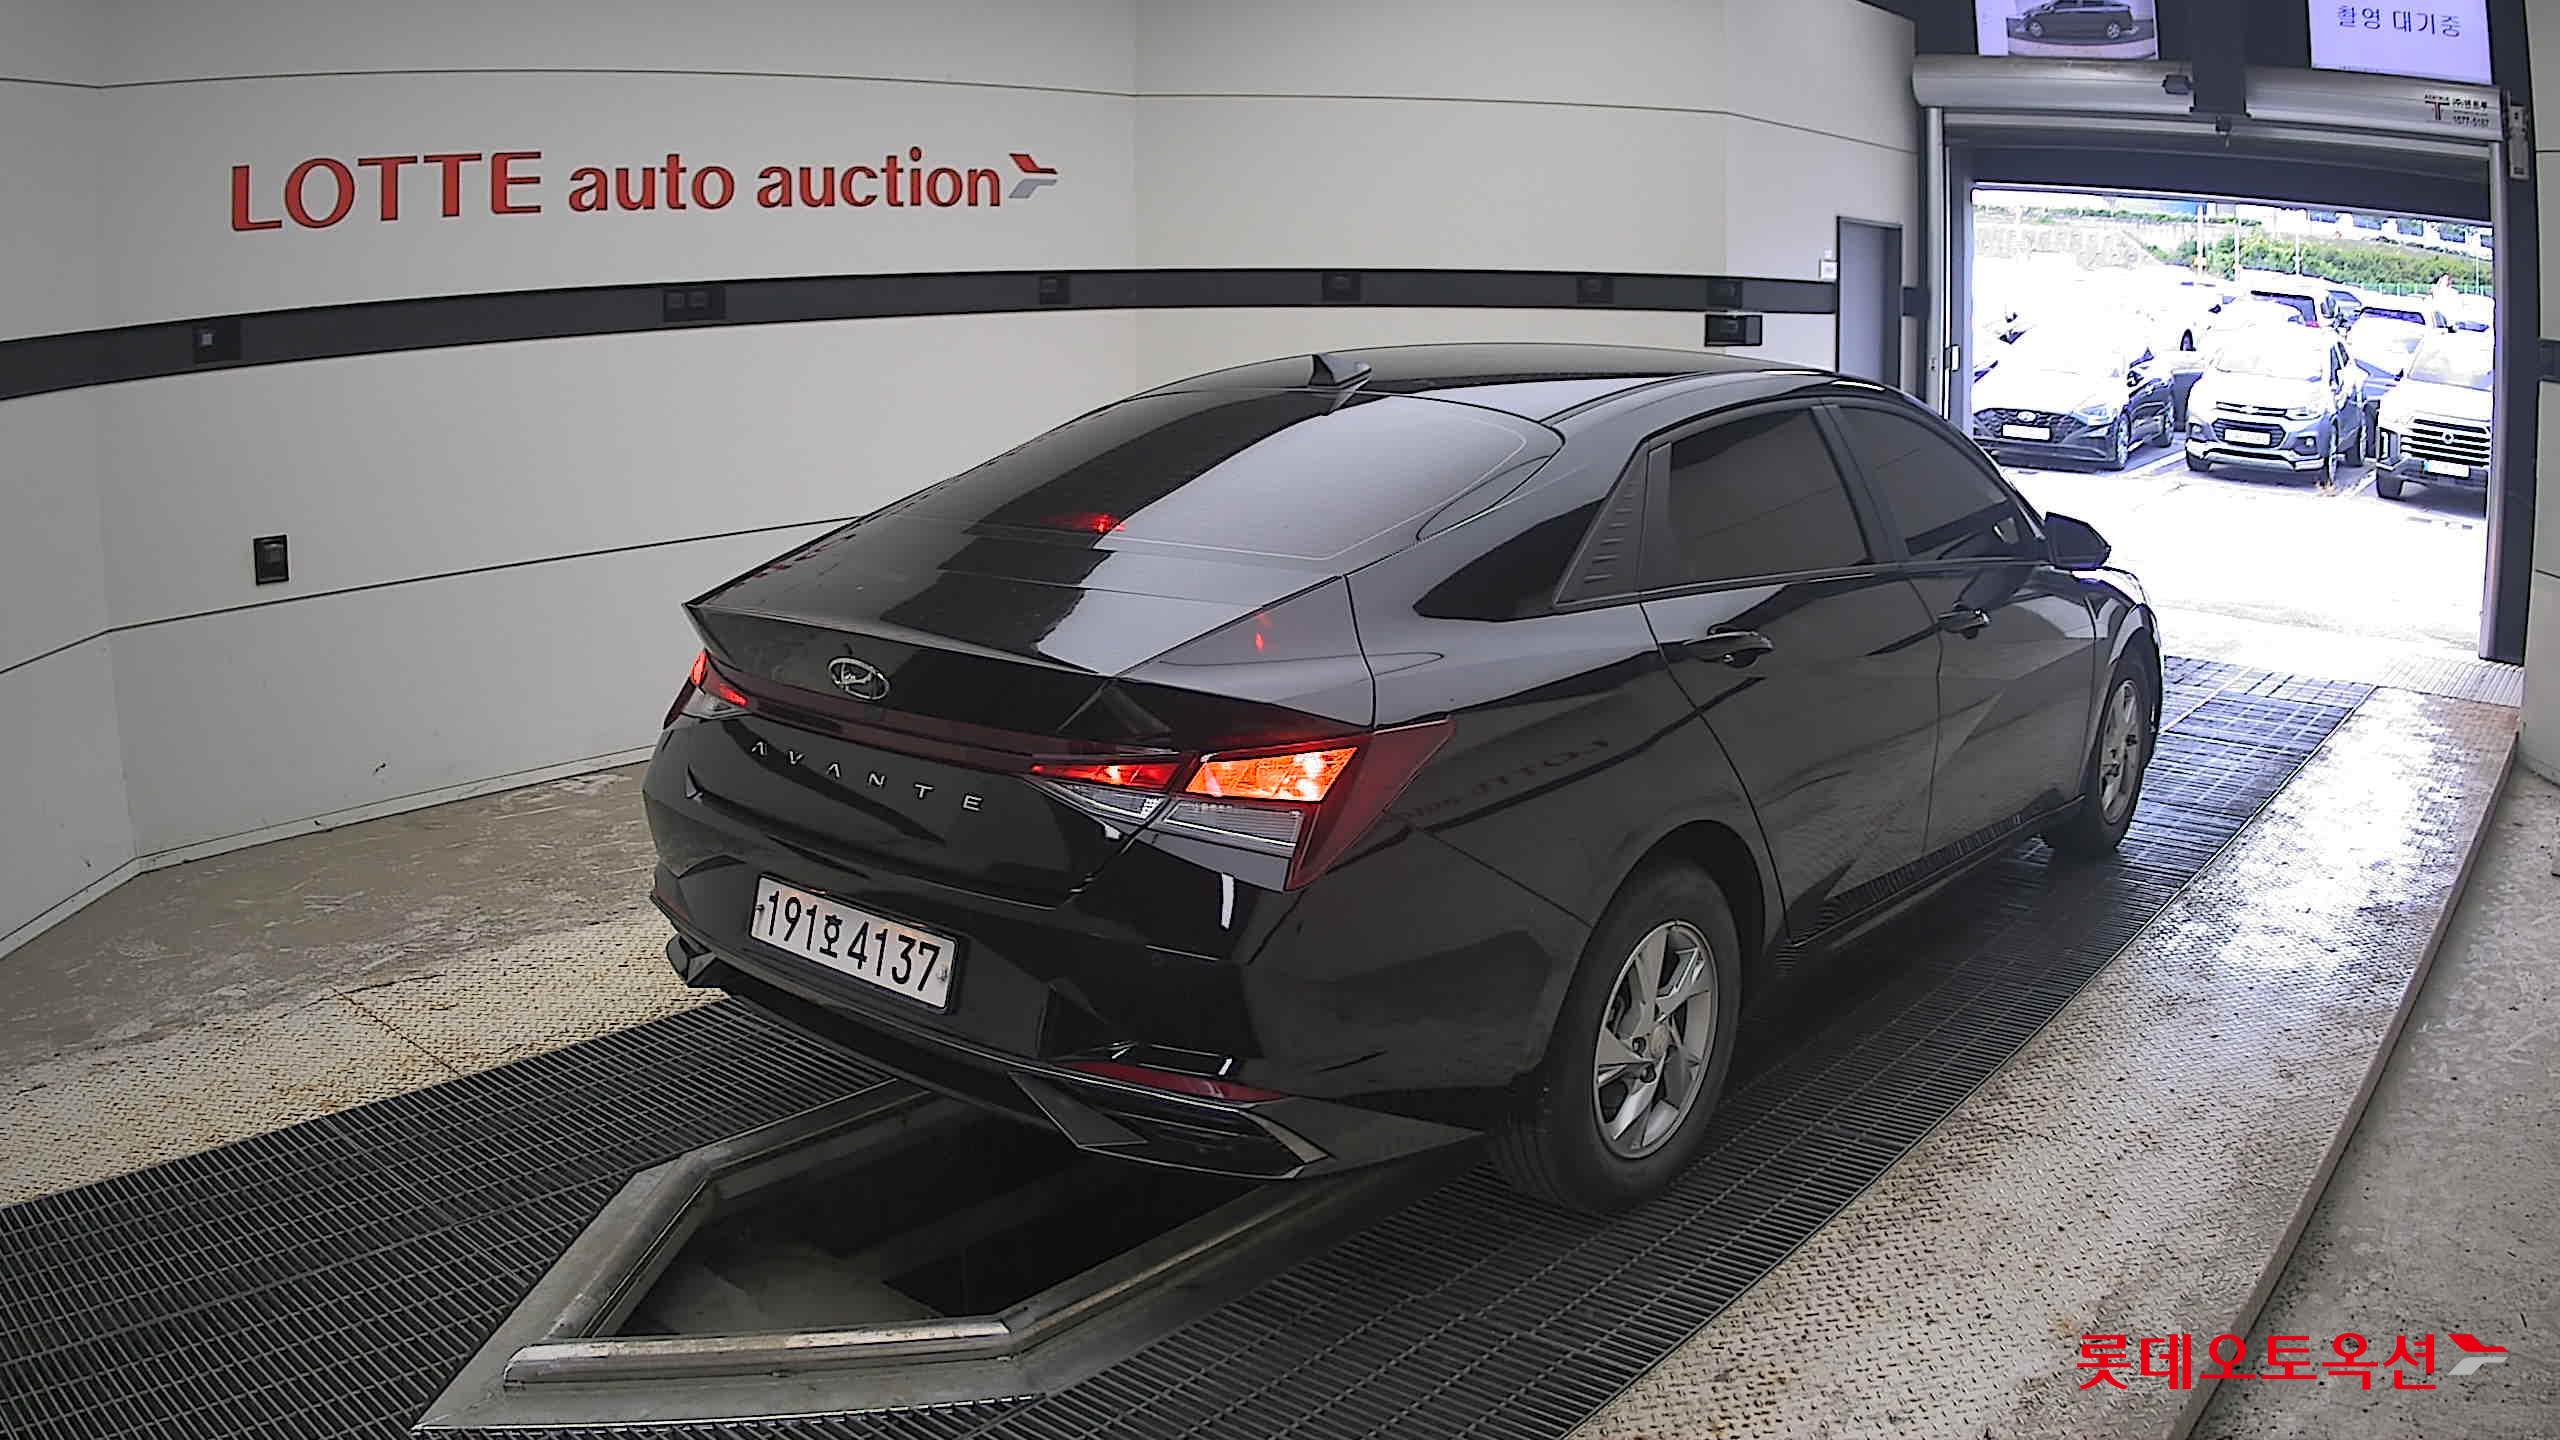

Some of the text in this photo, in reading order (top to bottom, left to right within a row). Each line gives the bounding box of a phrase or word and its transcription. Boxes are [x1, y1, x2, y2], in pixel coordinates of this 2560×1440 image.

[2338, 5, 2462, 38] 촬영 대기중
[231, 146, 1002, 232] LOTTE auto auction
[752, 740, 983, 812] AVANTE
